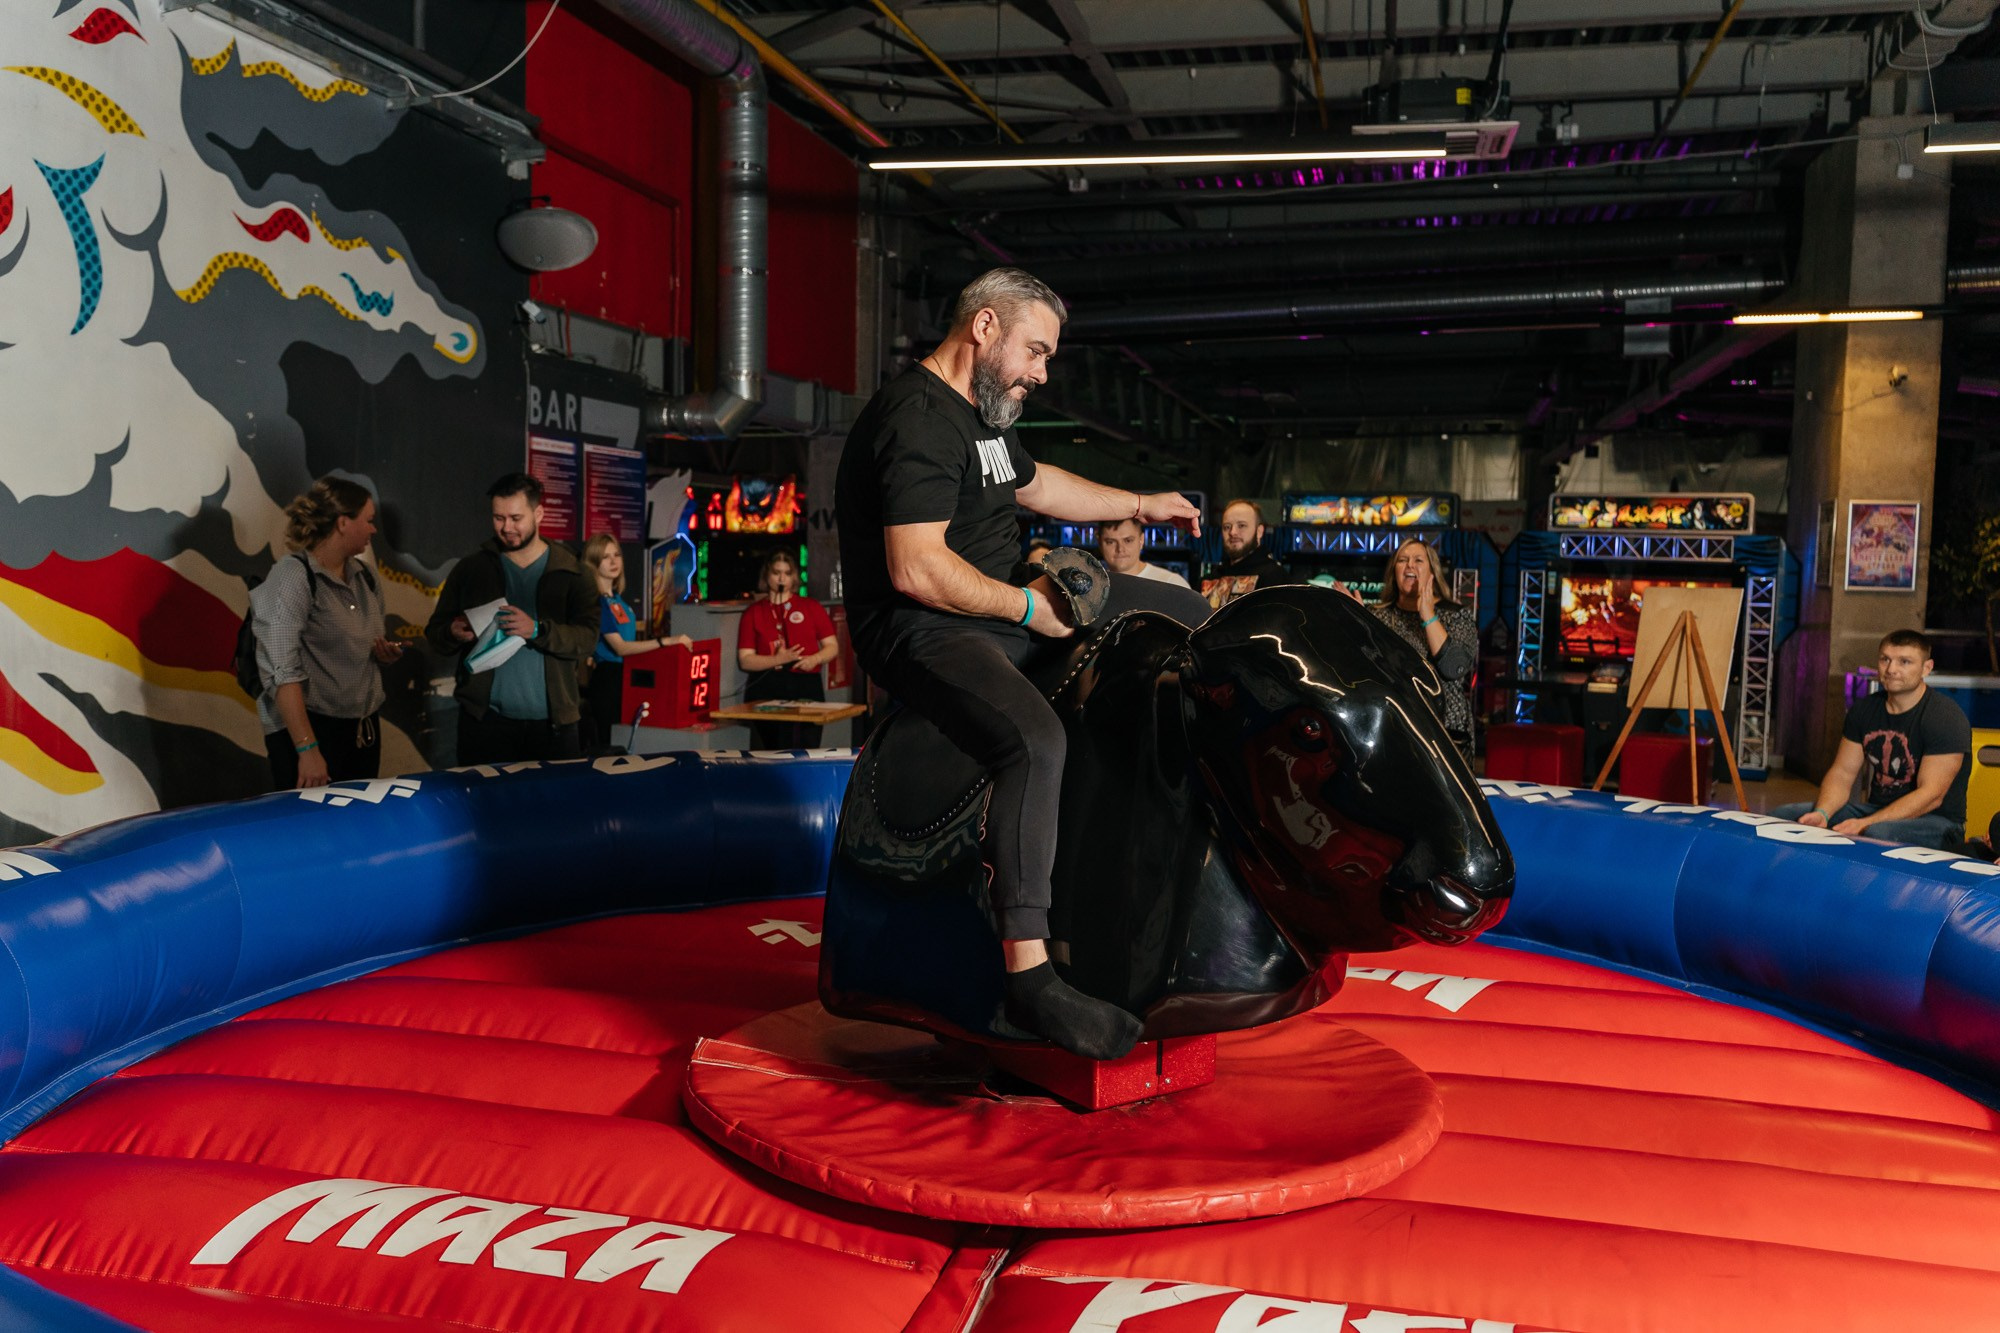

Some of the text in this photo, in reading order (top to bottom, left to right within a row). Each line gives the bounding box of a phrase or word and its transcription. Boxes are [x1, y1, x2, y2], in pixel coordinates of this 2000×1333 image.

[529, 384, 577, 432] BAR
[691, 654, 709, 679] 02
[694, 682, 708, 706] 12
